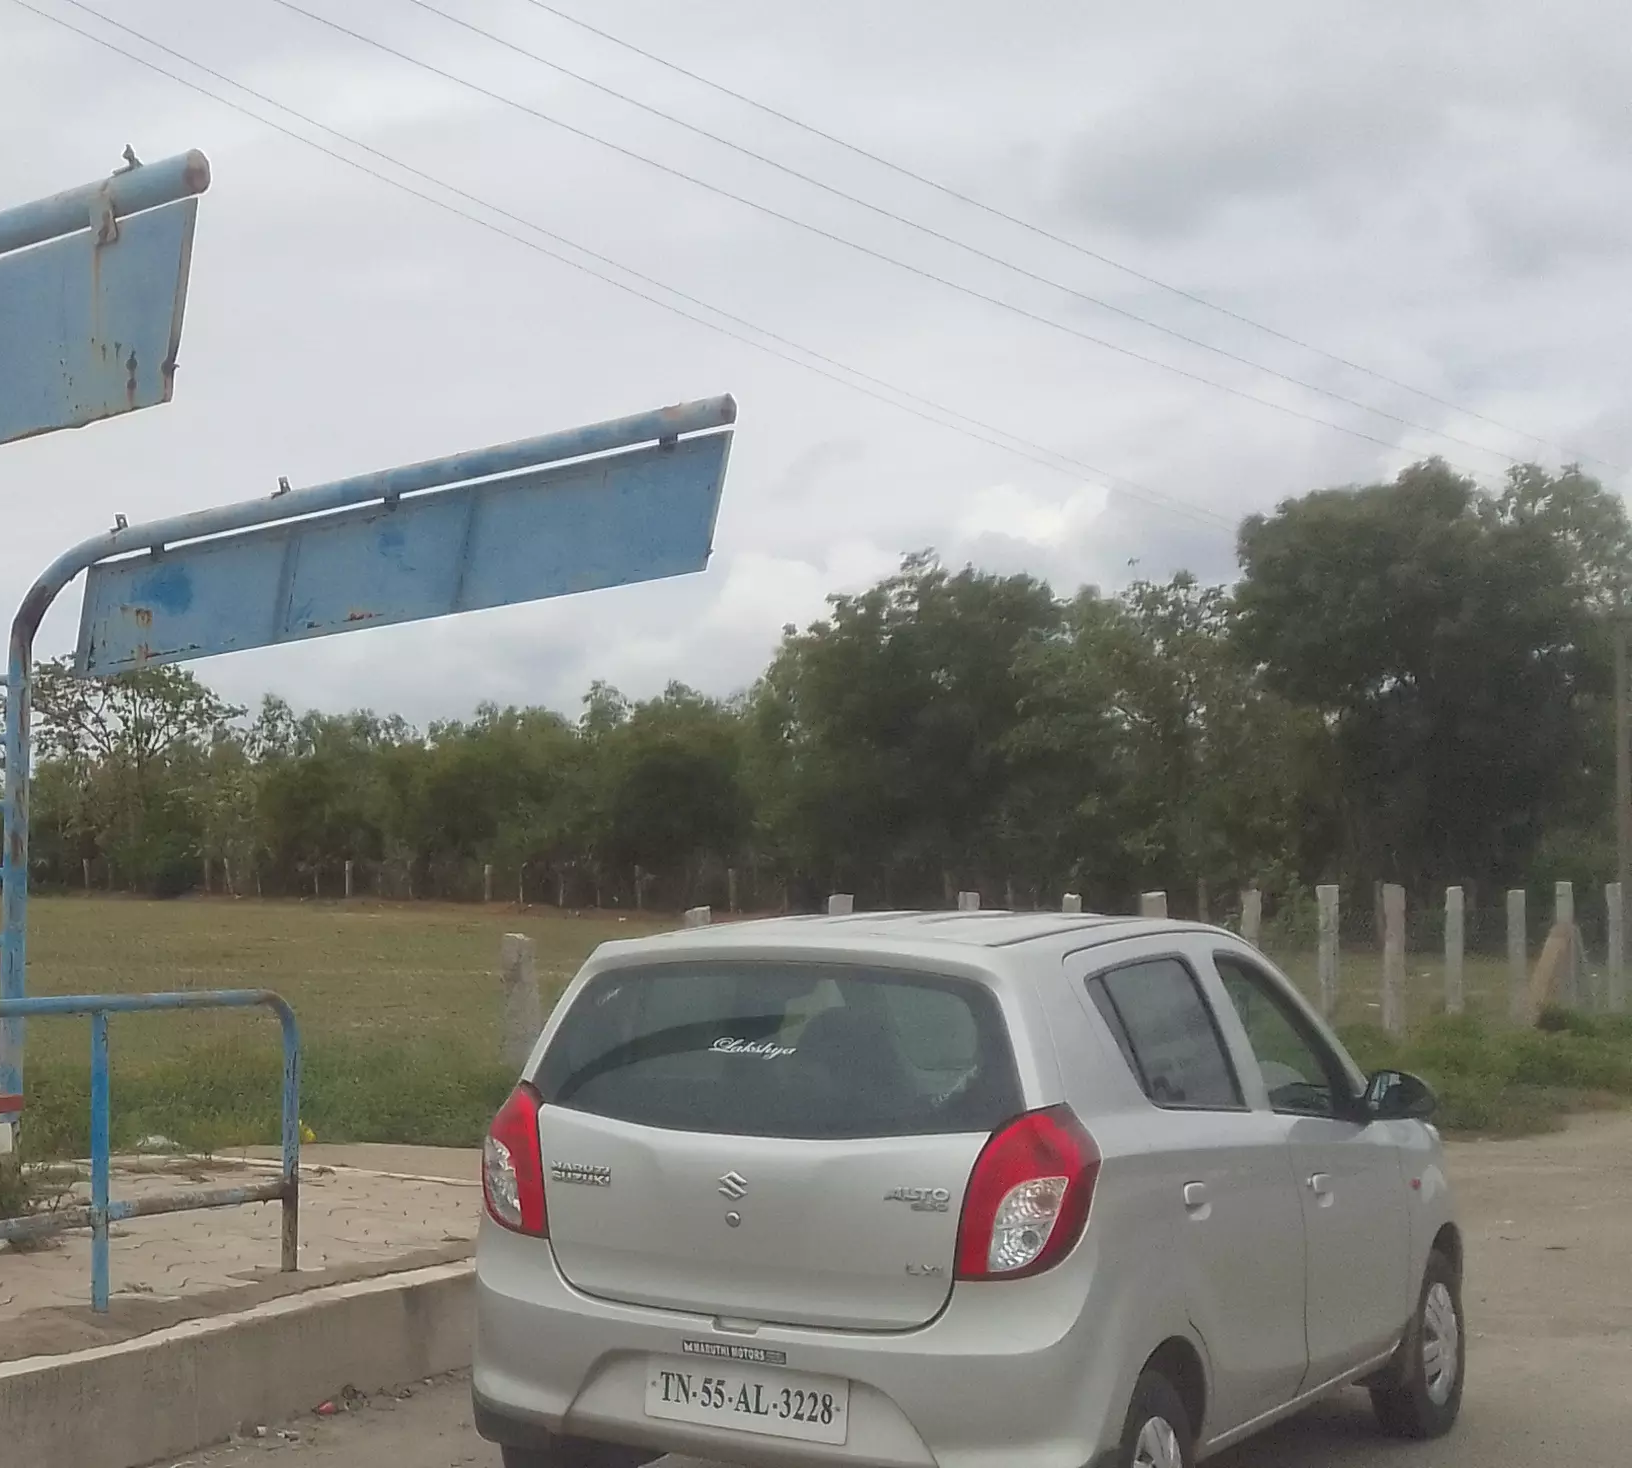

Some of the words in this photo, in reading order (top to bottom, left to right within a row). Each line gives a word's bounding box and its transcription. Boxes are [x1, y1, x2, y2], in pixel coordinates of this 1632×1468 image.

[708, 1037, 797, 1060] Lakshya
[551, 1171, 611, 1187] SUZUKI
[882, 1187, 950, 1203] ALTO
[731, 1347, 765, 1361] MOTORS
